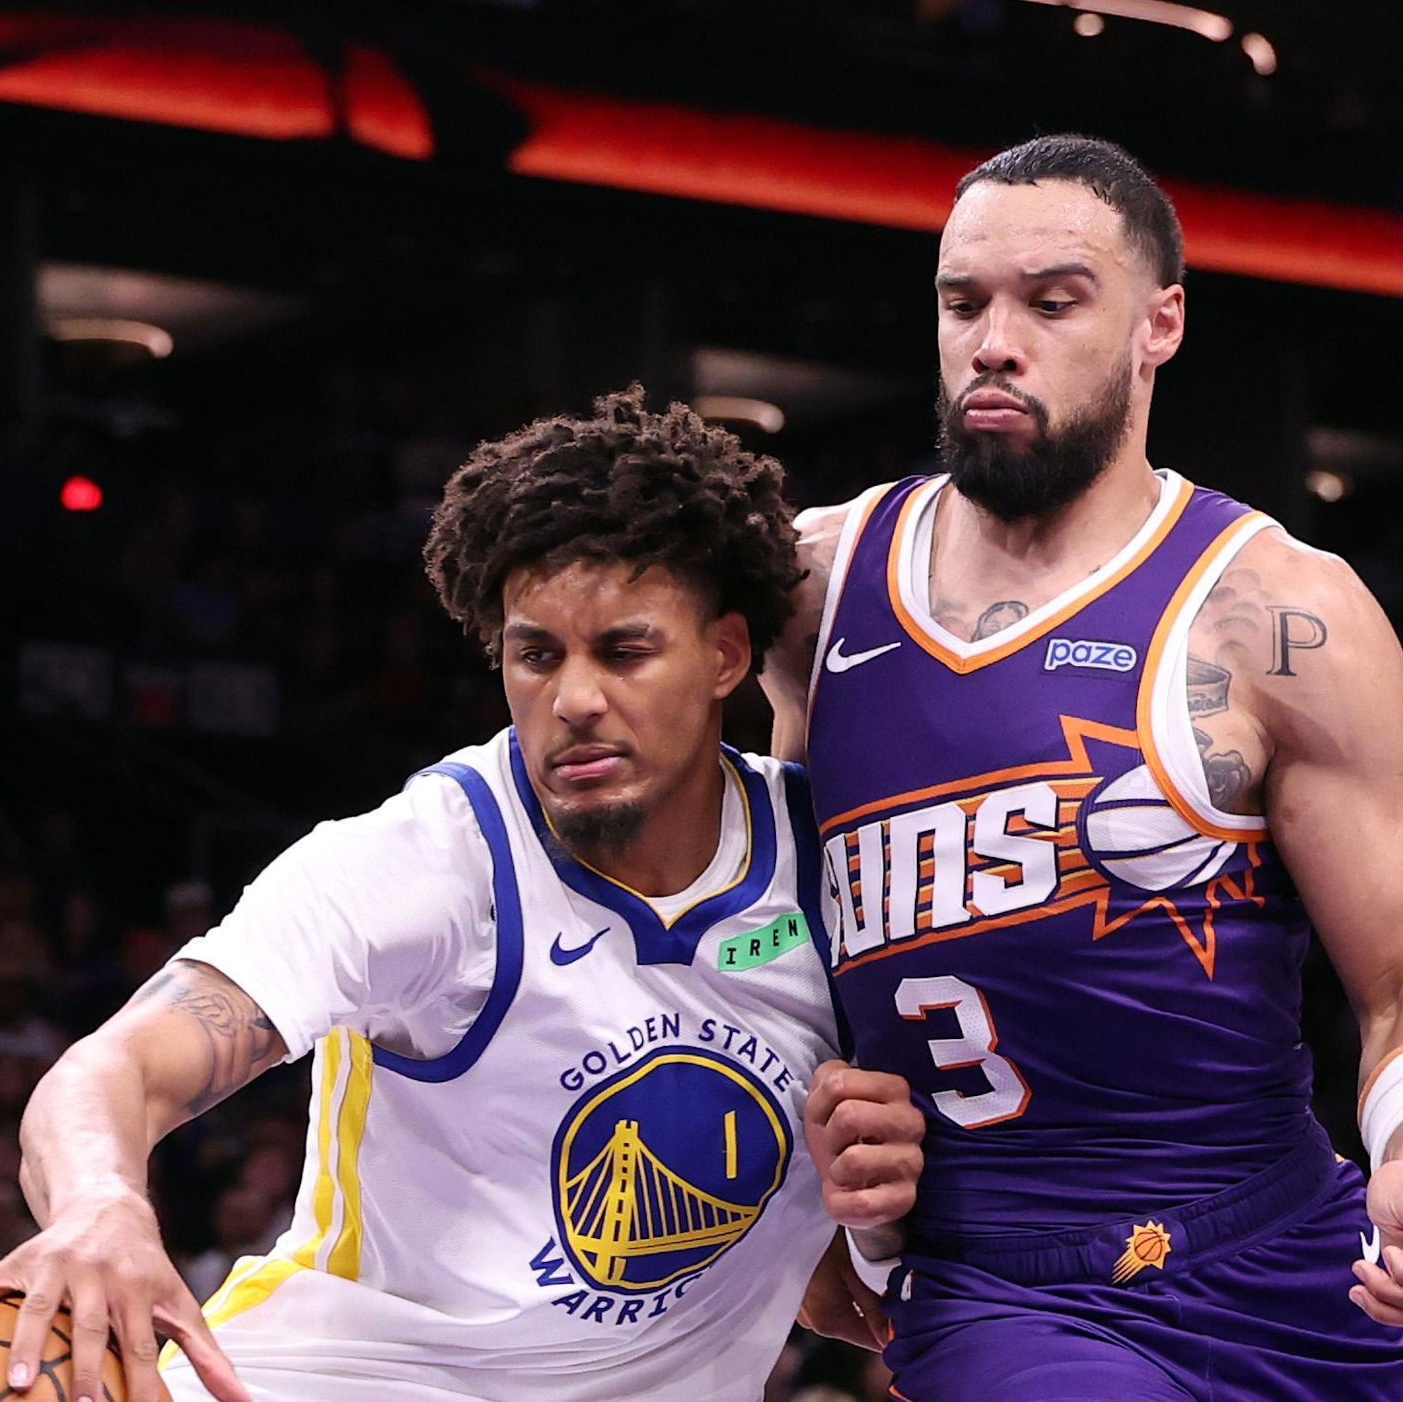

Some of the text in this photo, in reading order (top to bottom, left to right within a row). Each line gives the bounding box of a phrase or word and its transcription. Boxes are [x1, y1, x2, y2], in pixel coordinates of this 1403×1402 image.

[1048, 642, 1133, 668] paze
[1265, 605, 1327, 677] P
[725, 918, 799, 965] IREN
[560, 1012, 794, 1092] GOLDEN STATE
[894, 975, 1032, 1129] 3
[723, 1110, 738, 1180] 1
